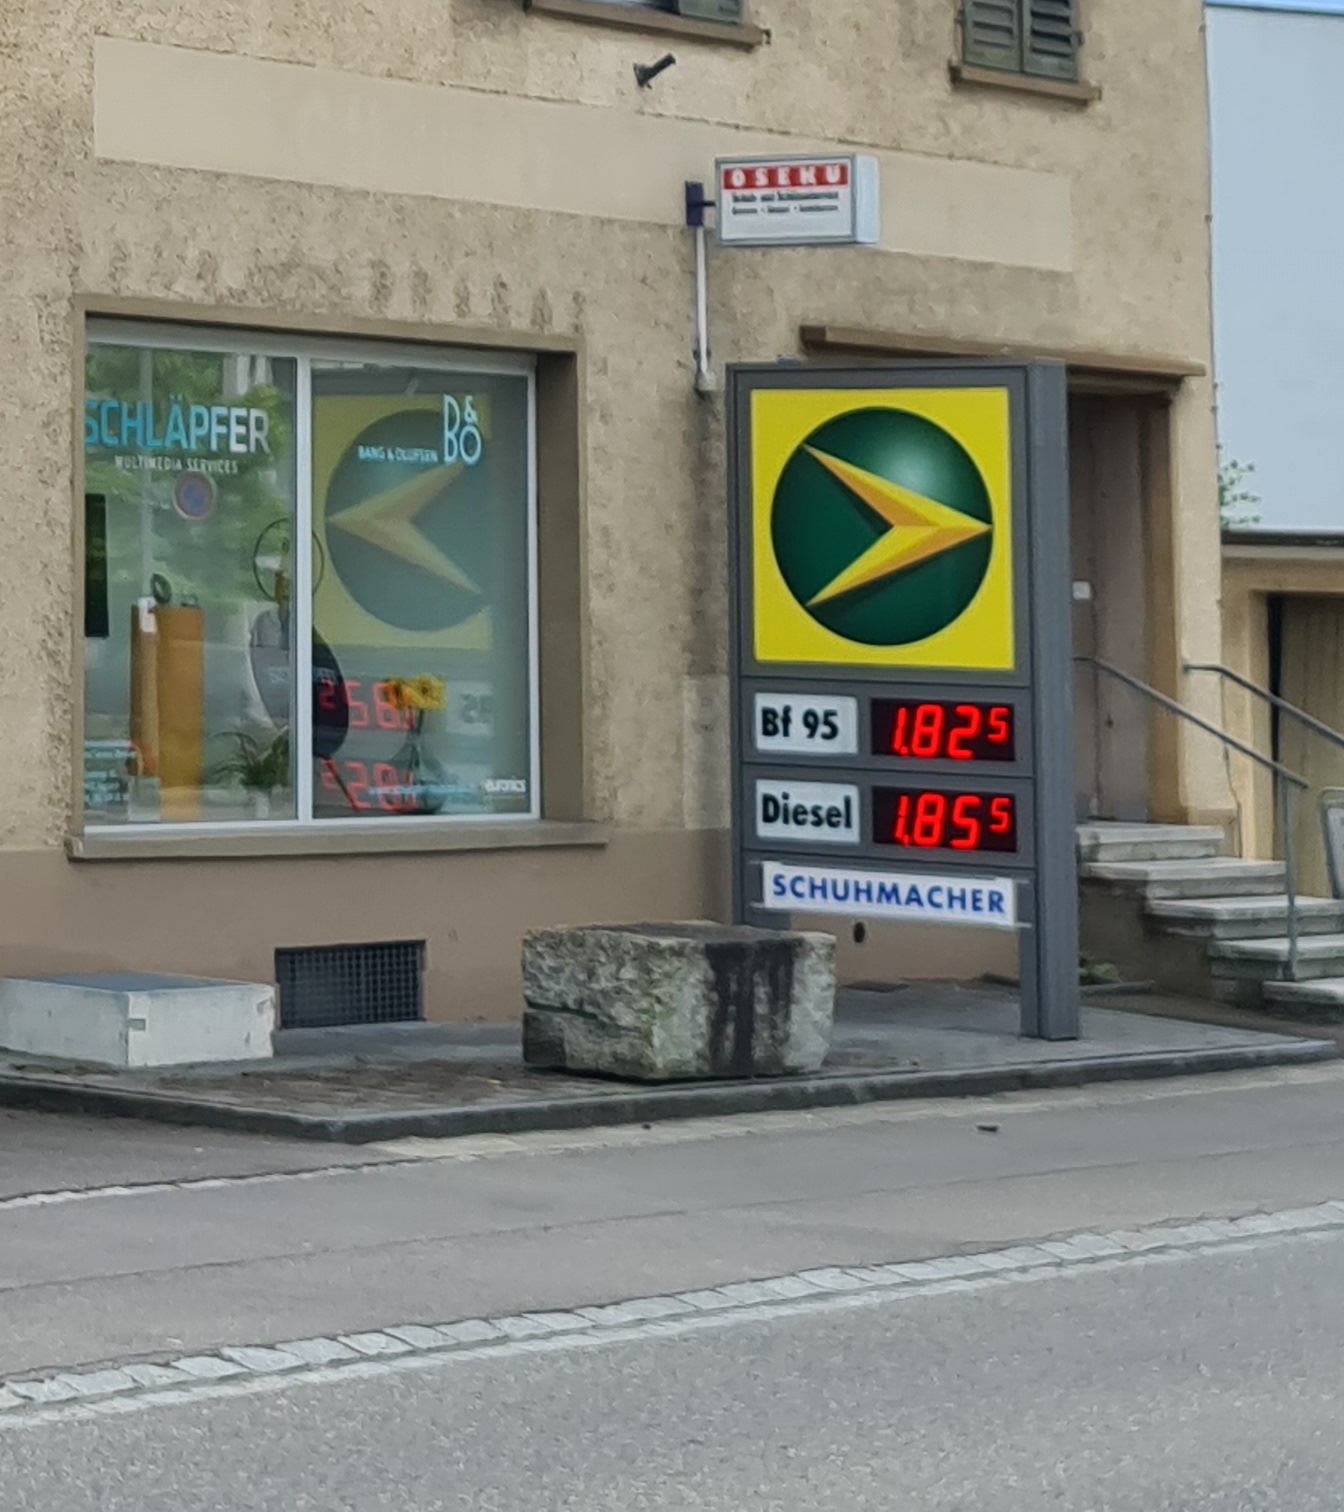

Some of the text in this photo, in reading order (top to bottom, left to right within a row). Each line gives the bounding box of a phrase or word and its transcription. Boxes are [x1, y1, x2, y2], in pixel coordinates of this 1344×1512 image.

[85, 394, 271, 453] SCHLÄPFER
[115, 455, 238, 474] MULTIMEDIA SERVICES
[761, 705, 839, 740] Bf 95
[762, 791, 853, 830] Diesel
[772, 874, 1005, 914] SCHUHMACHER
